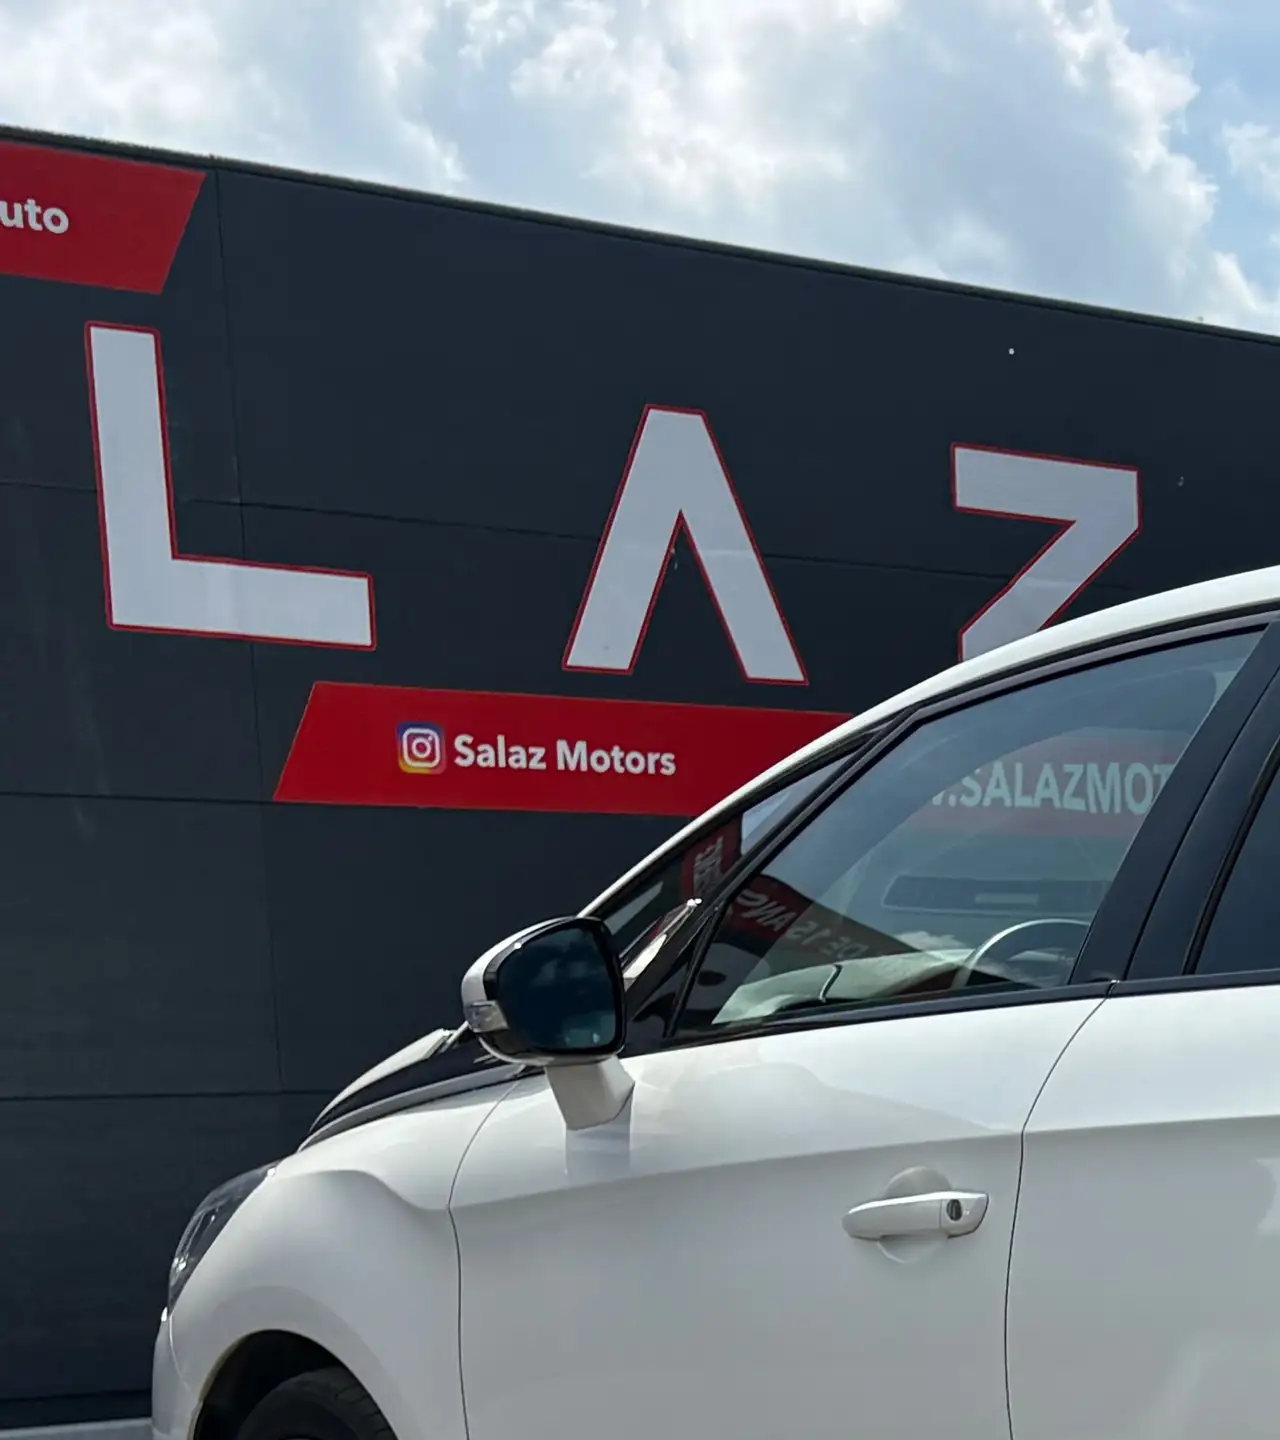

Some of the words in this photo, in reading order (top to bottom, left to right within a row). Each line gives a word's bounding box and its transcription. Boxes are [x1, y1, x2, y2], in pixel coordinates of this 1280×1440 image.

[0, 198, 70, 234] uto
[453, 734, 547, 771] Salaz
[555, 739, 677, 776] Motors
